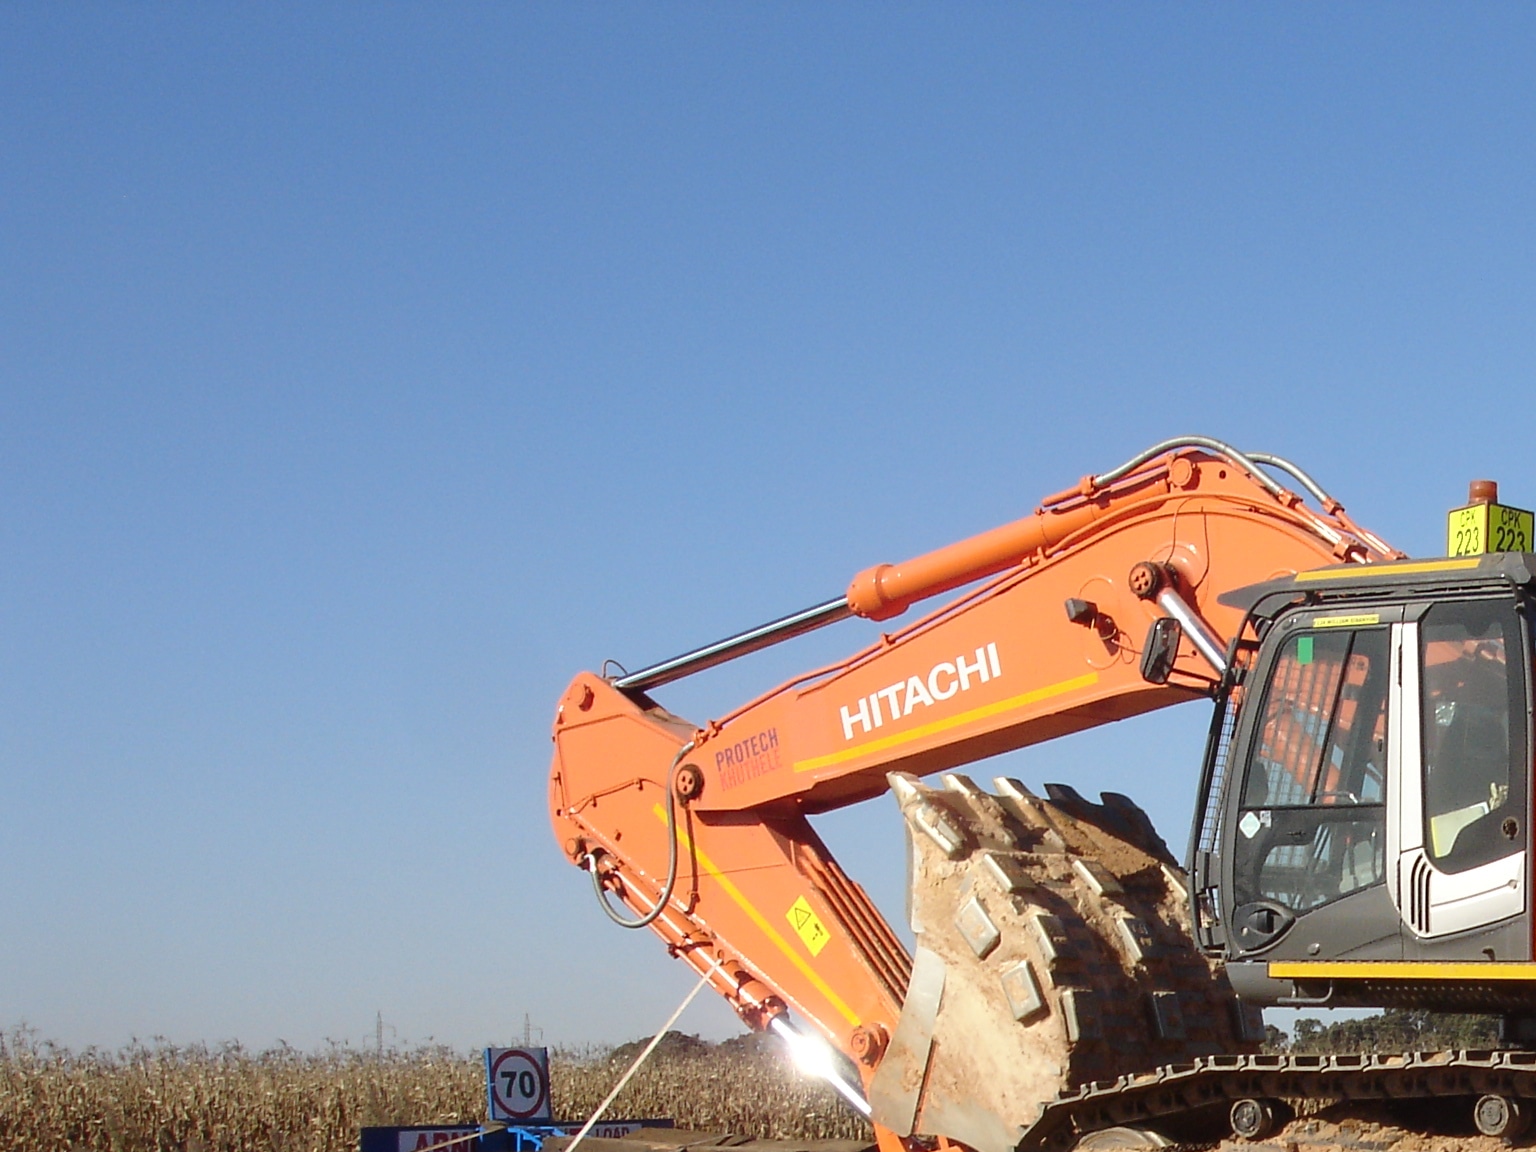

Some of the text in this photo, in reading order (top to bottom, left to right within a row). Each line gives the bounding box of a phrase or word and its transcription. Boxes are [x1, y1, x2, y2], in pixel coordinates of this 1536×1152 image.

[1501, 508, 1521, 529] CPK
[1456, 526, 1479, 556] 223
[1496, 525, 1525, 552] 223
[840, 642, 1002, 740] HITACHI
[715, 727, 779, 773] PROTECH
[720, 748, 783, 793] KHUTHELE
[500, 1070, 536, 1099] 70
